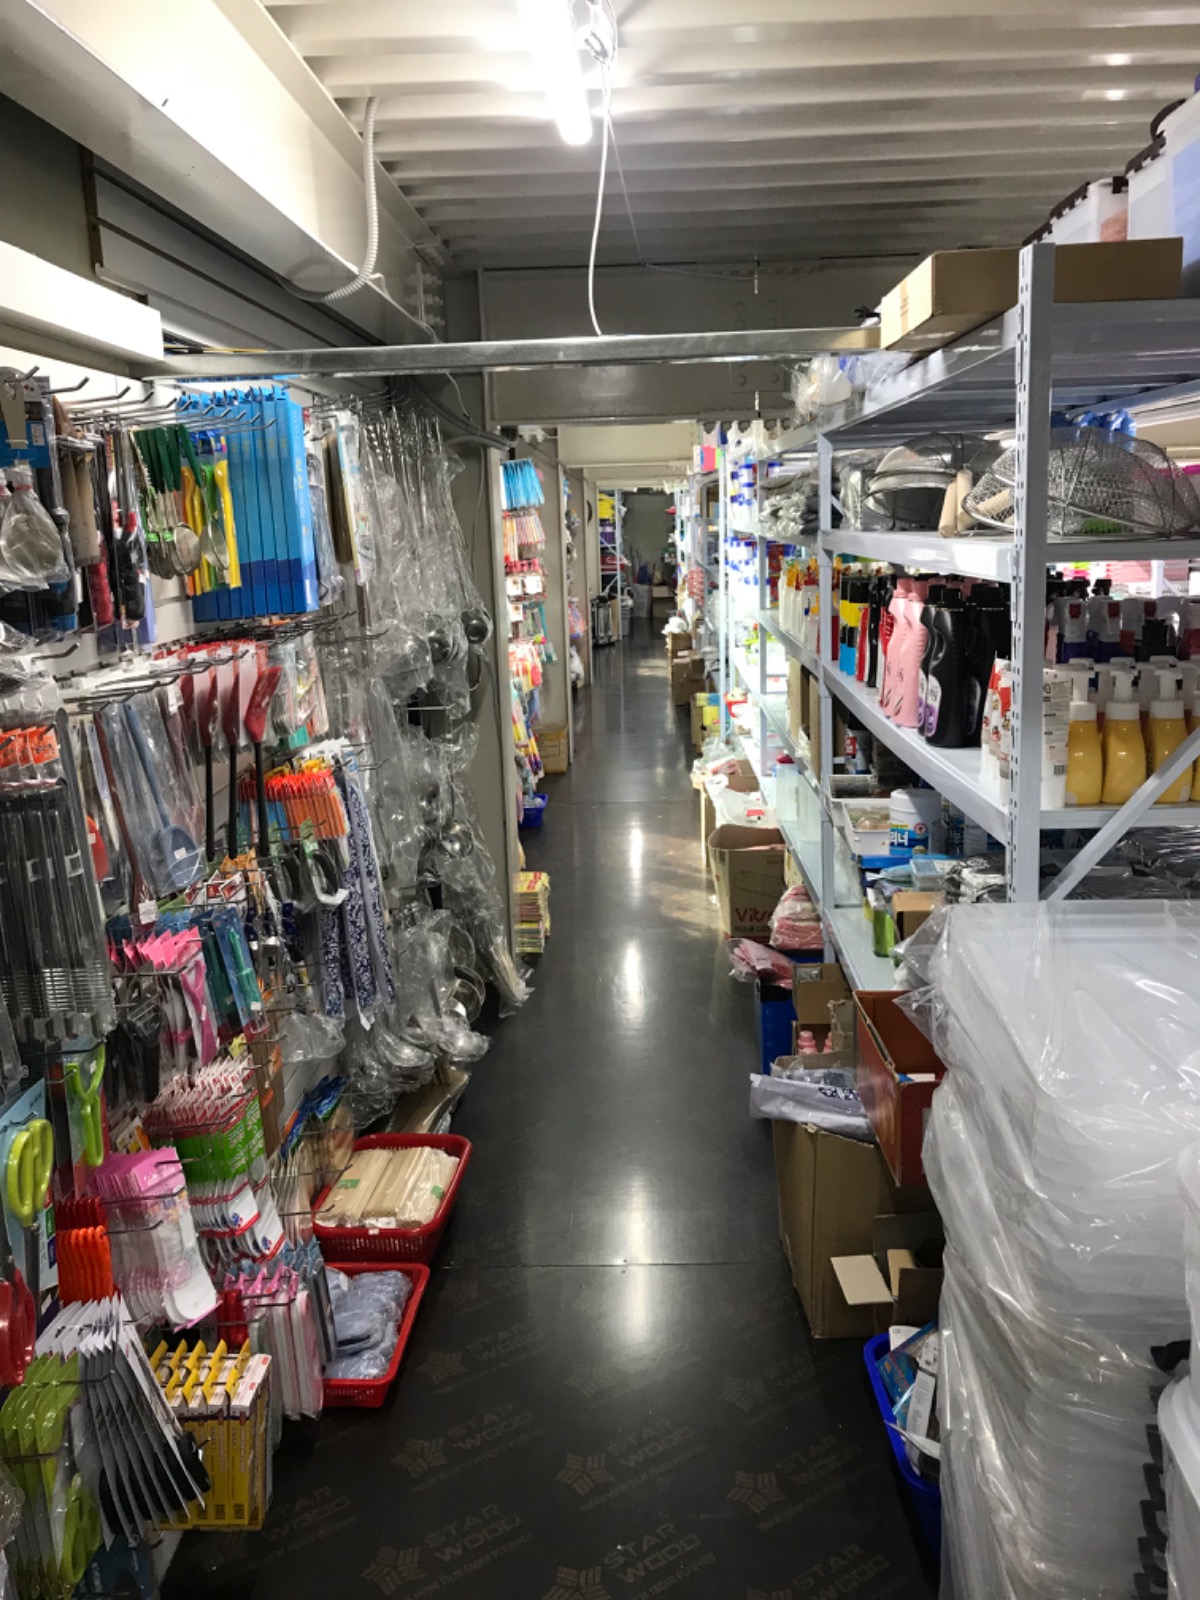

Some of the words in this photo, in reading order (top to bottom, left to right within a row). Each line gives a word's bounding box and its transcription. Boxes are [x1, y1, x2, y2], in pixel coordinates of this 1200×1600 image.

[422, 1503, 502, 1548] STAR
[435, 1513, 522, 1562] WOOD
[603, 1521, 679, 1570] STAR
[617, 1533, 702, 1584] WOOD
[792, 1543, 864, 1591] STAR
